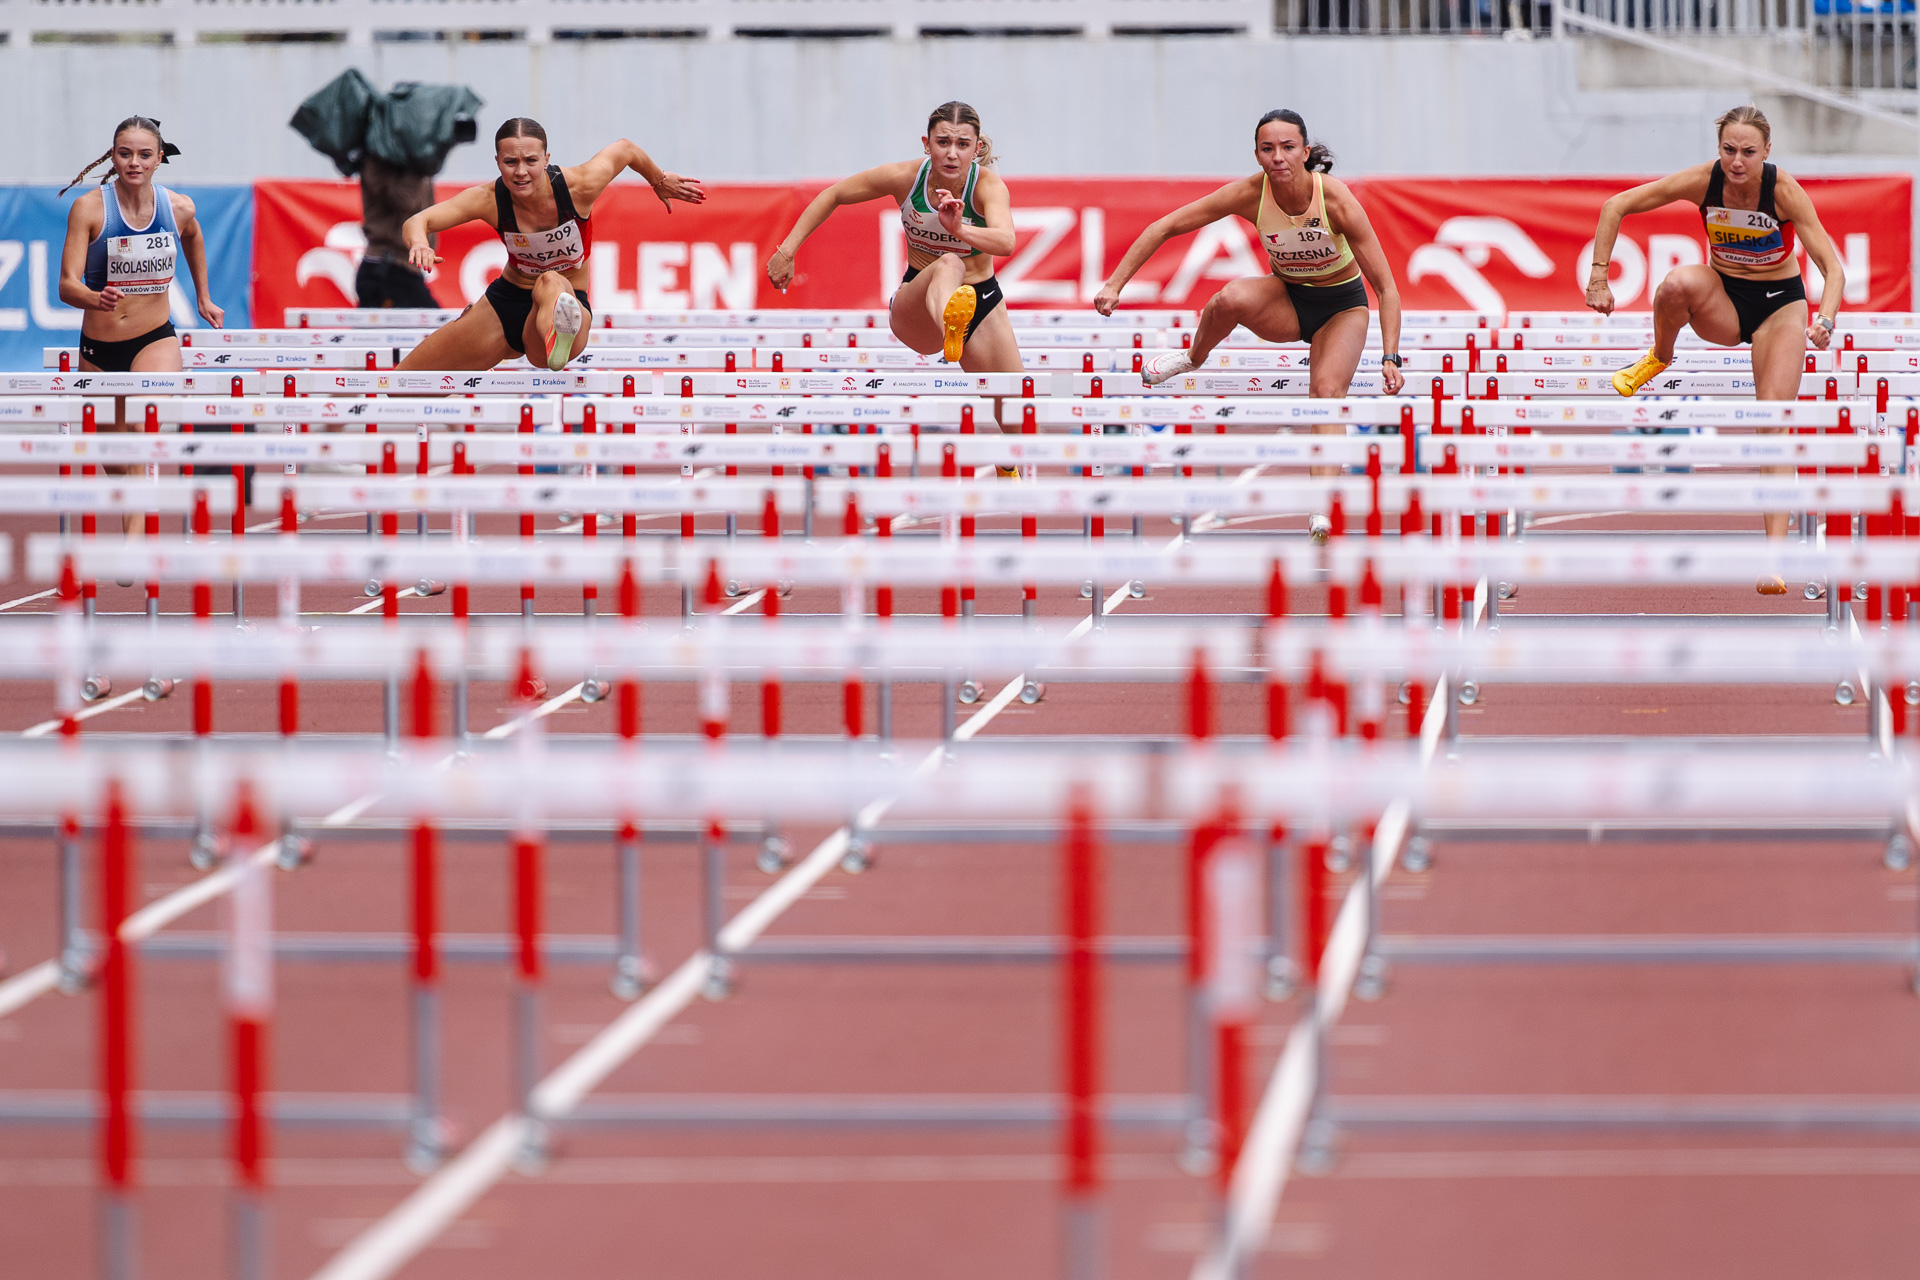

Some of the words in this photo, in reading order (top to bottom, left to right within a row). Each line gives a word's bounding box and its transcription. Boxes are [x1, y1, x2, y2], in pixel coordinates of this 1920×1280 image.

[1747, 214, 1772, 229] 210
[545, 226, 572, 243] 209
[903, 220, 962, 243] GOZDER
[1298, 231, 1322, 242] 187
[146, 236, 170, 249] 281
[1714, 231, 1776, 247] SIELSKA
[880, 206, 1266, 303] ZLA
[1267, 246, 1335, 261] SZCZĘSNA
[1725, 254, 1754, 263] KRAKÓW
[110, 256, 174, 274] SKOLASIŃSKA
[459, 239, 758, 310] OLEN
[73, 379, 93, 389] 4F
[464, 377, 482, 388] 4F
[865, 379, 884, 389] 4F
[1271, 379, 1290, 389] 4F
[1663, 379, 1682, 390] 4F
